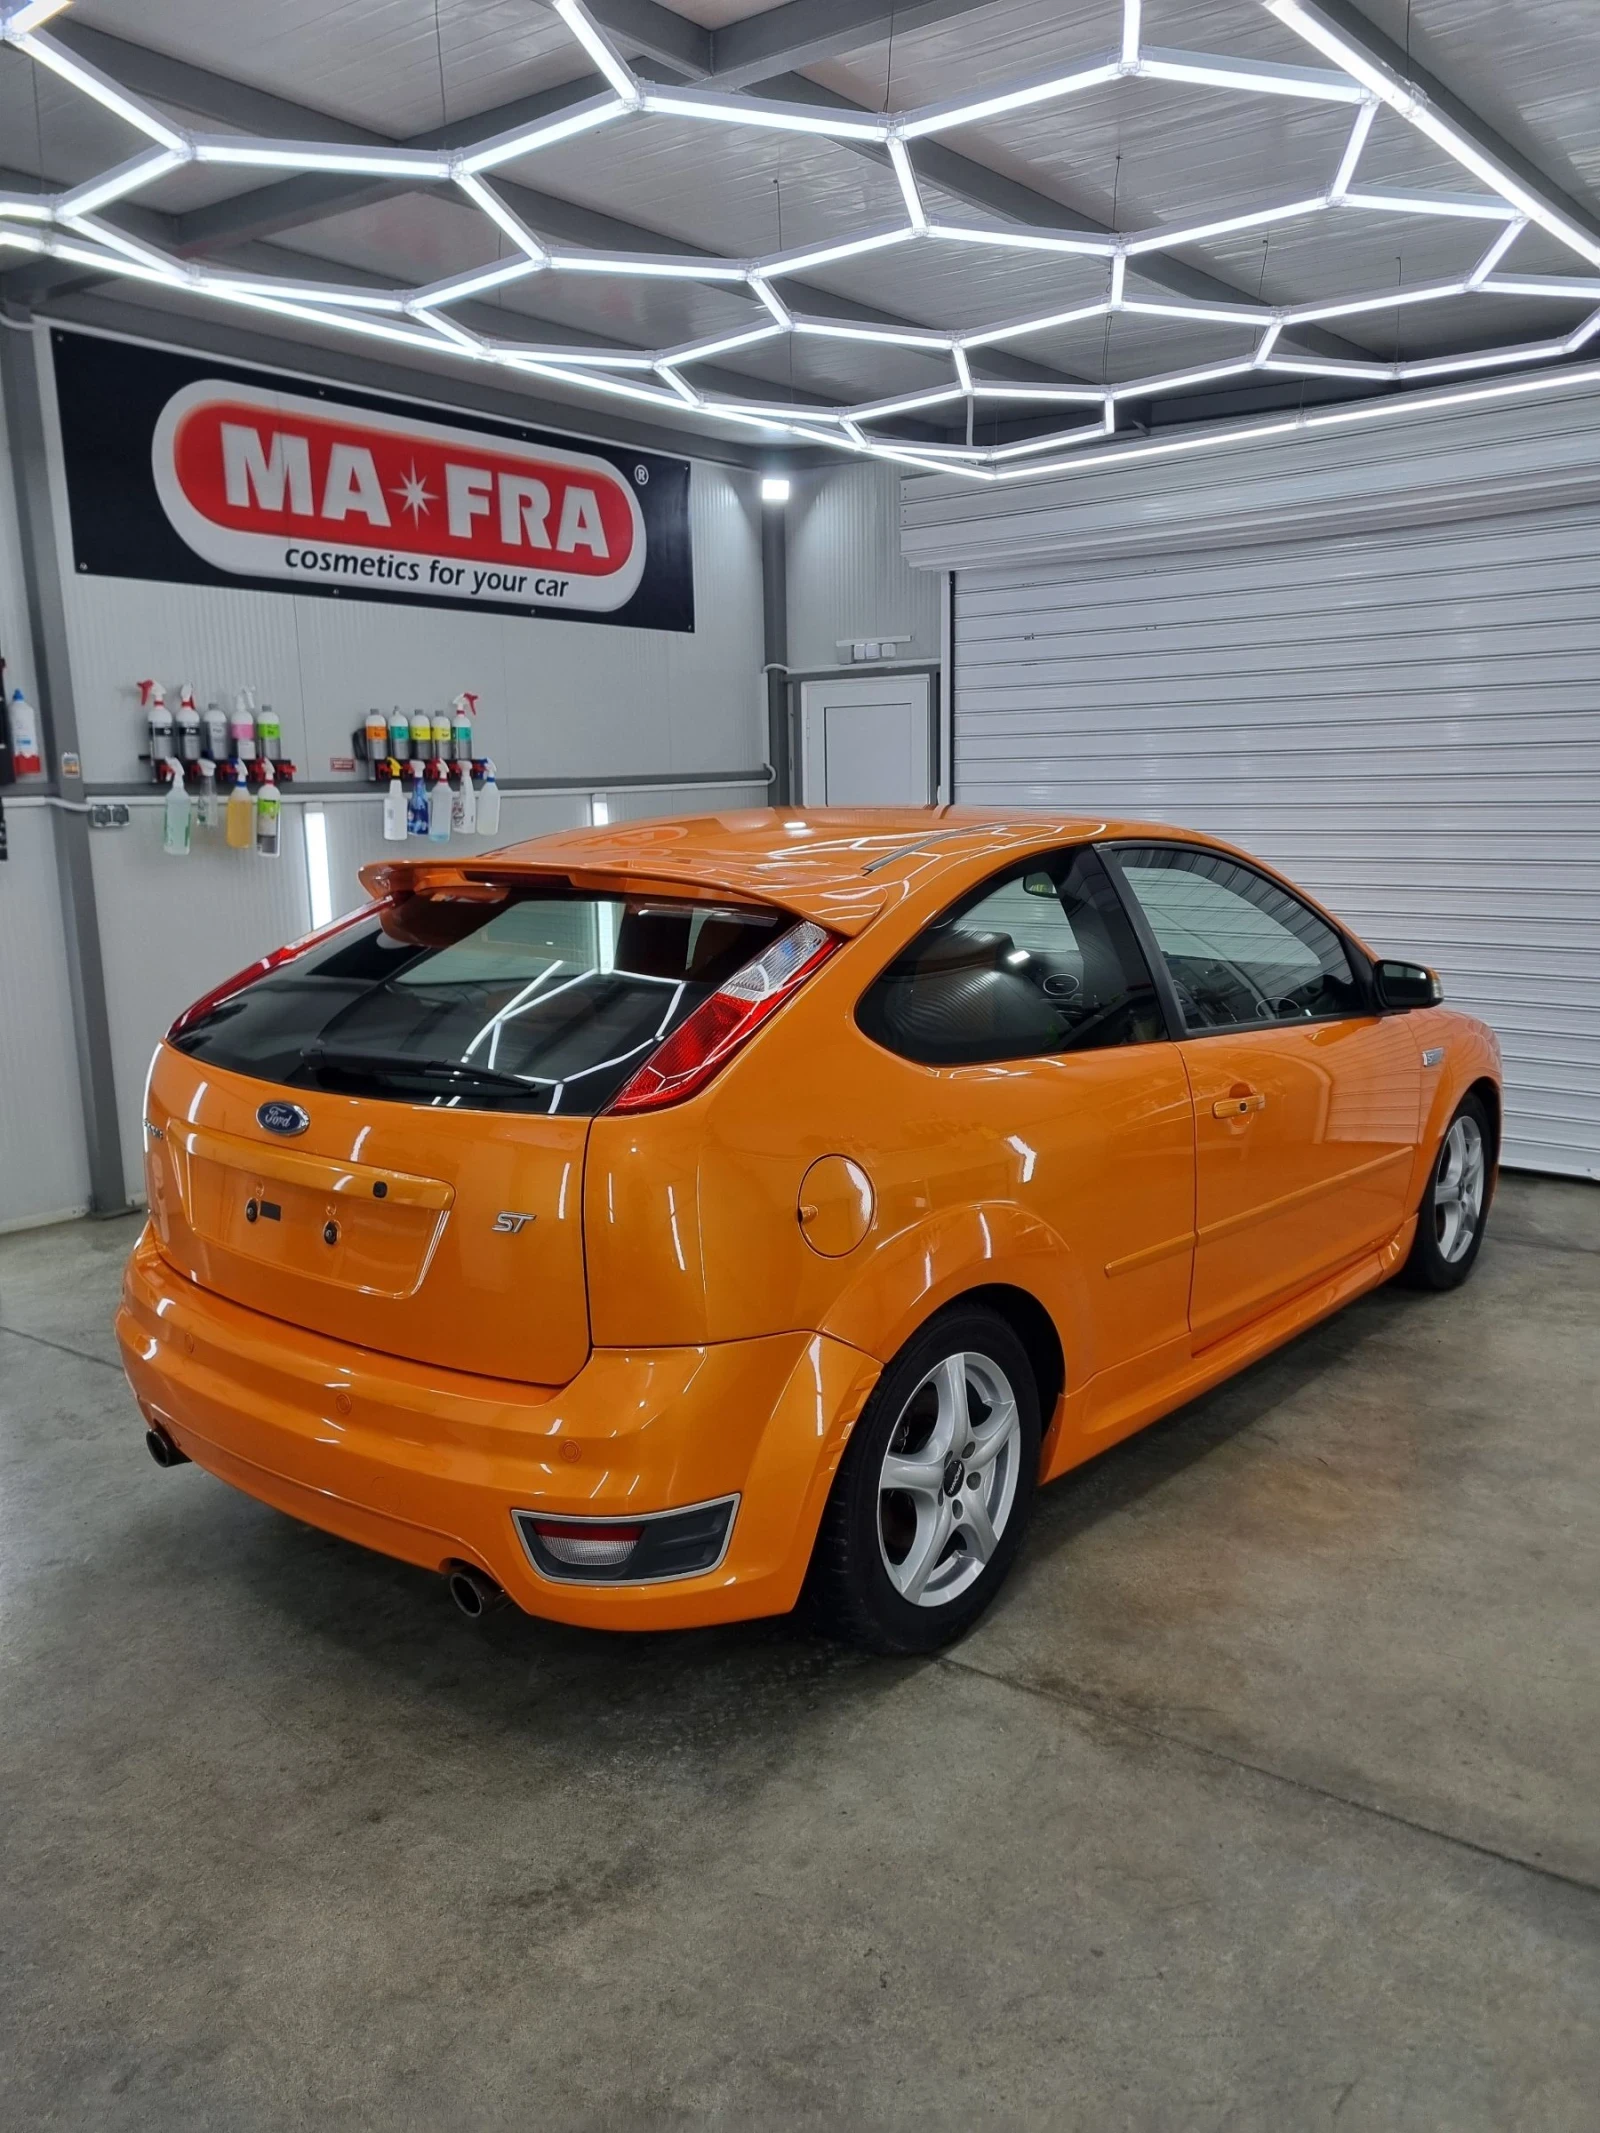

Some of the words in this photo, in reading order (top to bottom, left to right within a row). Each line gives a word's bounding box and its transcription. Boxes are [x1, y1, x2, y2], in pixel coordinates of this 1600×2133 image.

[220, 422, 392, 528] MA
[445, 463, 610, 558] FRA
[285, 548, 420, 581] cosmetics
[429, 559, 465, 586] for
[470, 570, 528, 595] your
[534, 578, 569, 597] car
[265, 1106, 292, 1127] Ford
[491, 1210, 537, 1233] ST
